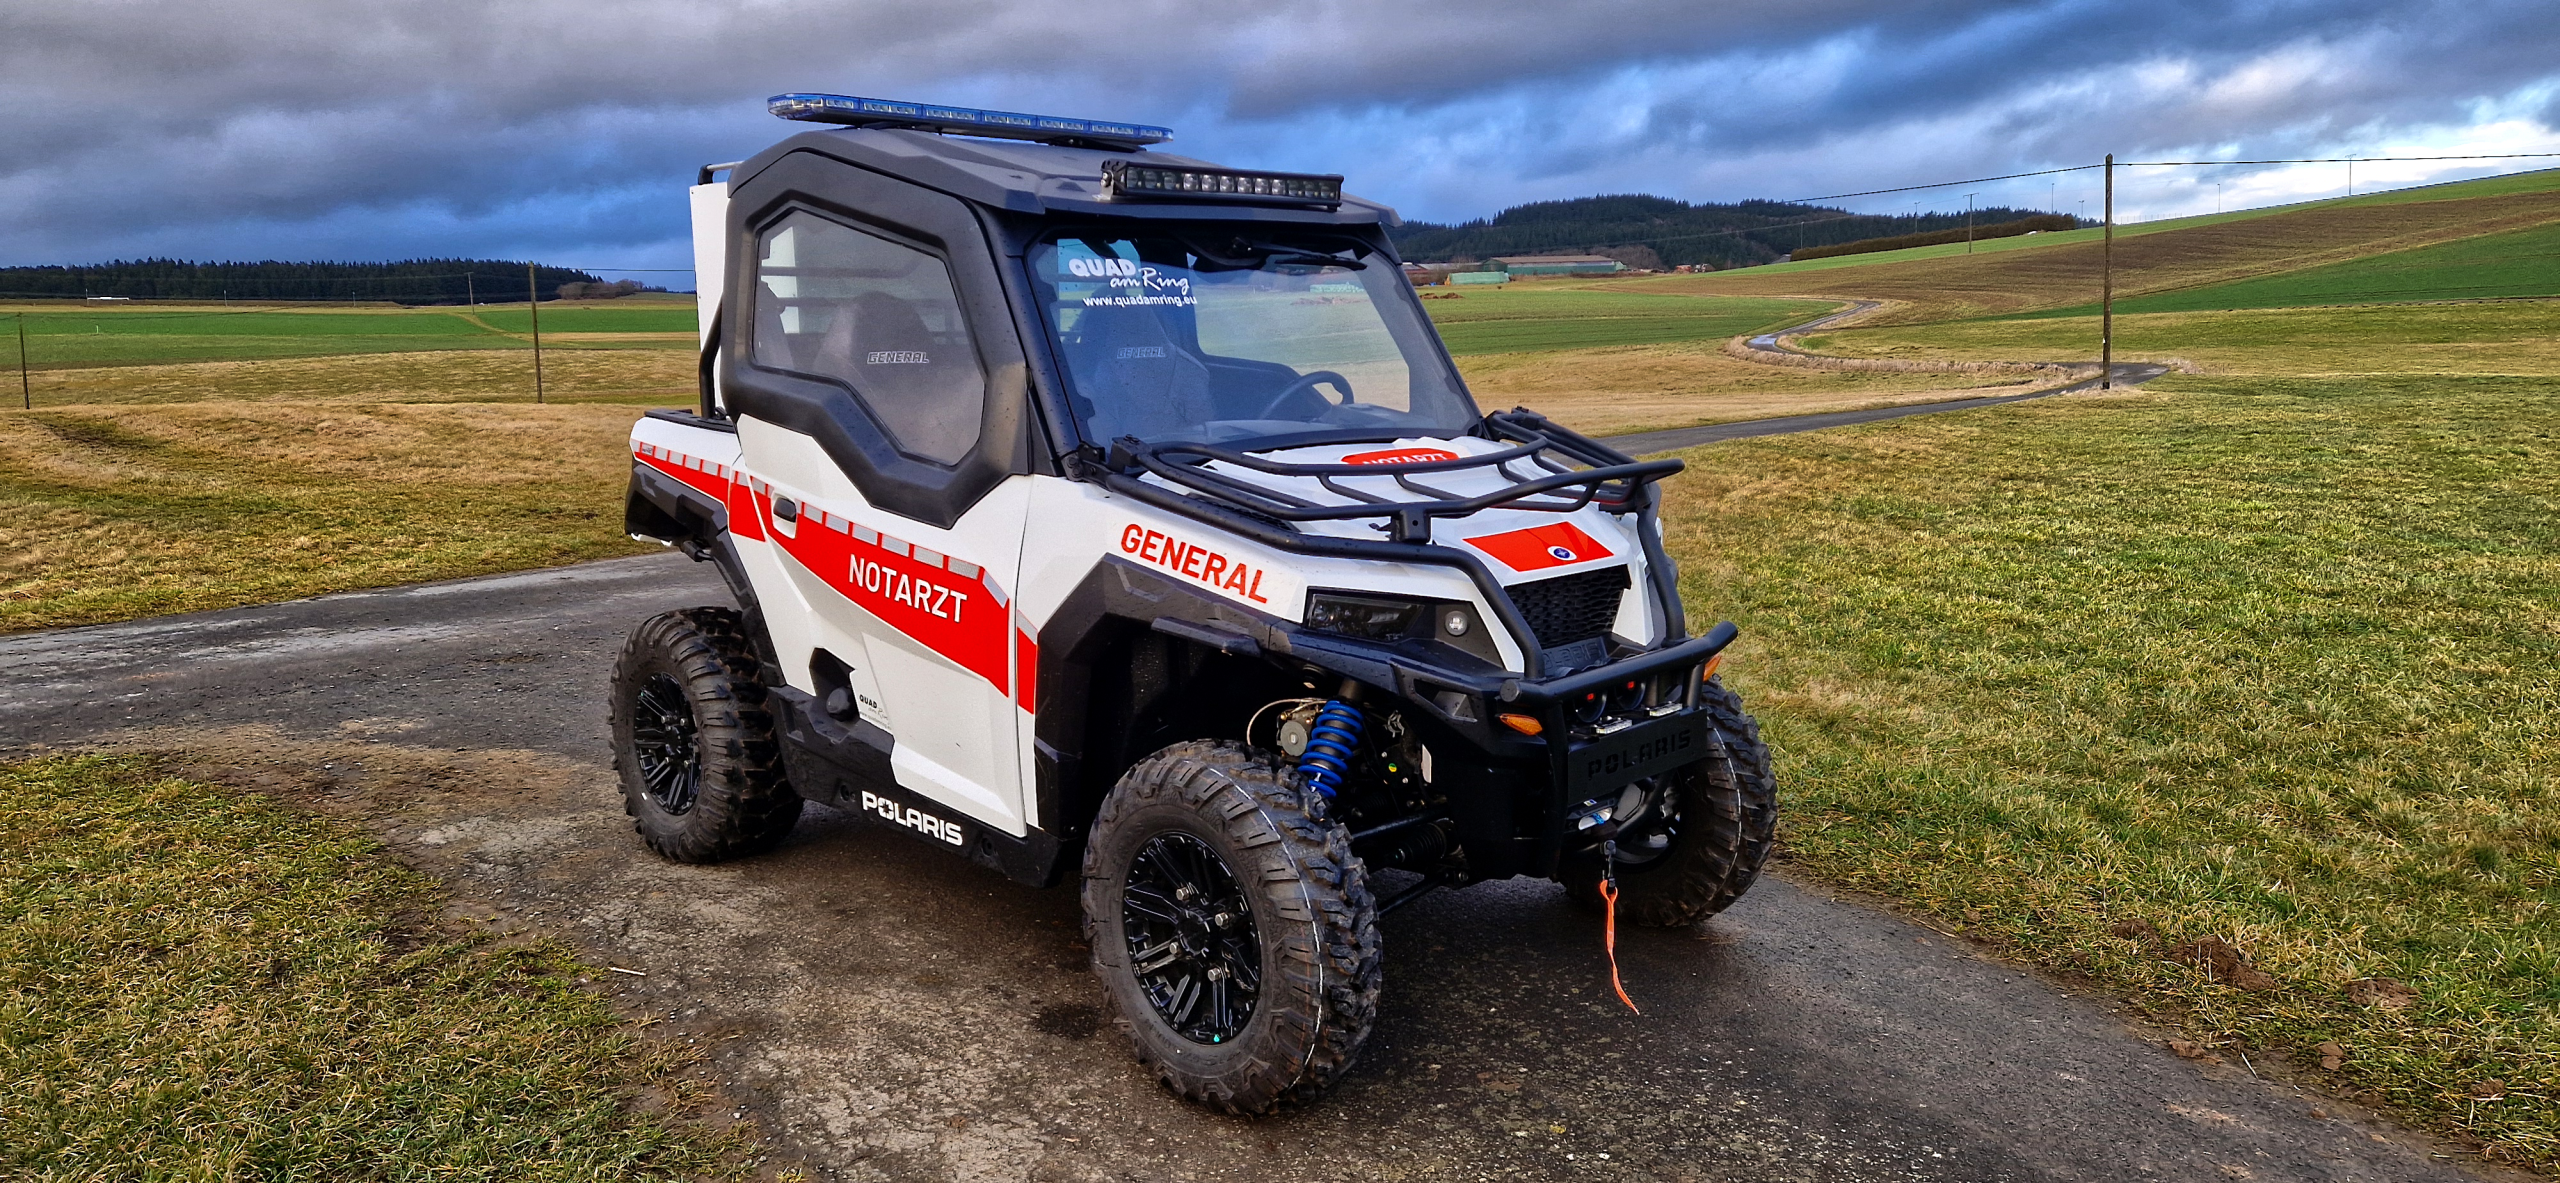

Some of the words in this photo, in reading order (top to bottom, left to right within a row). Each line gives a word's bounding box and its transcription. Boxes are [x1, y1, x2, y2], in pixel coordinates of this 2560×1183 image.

[1069, 258, 1137, 277] QUAD
[1110, 277, 1140, 288] am
[1139, 267, 1190, 295] Ring
[1082, 294, 1198, 308] www.quadamring.eu
[867, 350, 930, 364] GENERAL
[1121, 523, 1268, 604] GENERAL
[848, 553, 968, 623] NOTARZT
[859, 694, 877, 708] QUAD
[1587, 729, 1692, 781] POLARIS
[861, 790, 963, 847] POLARIS
